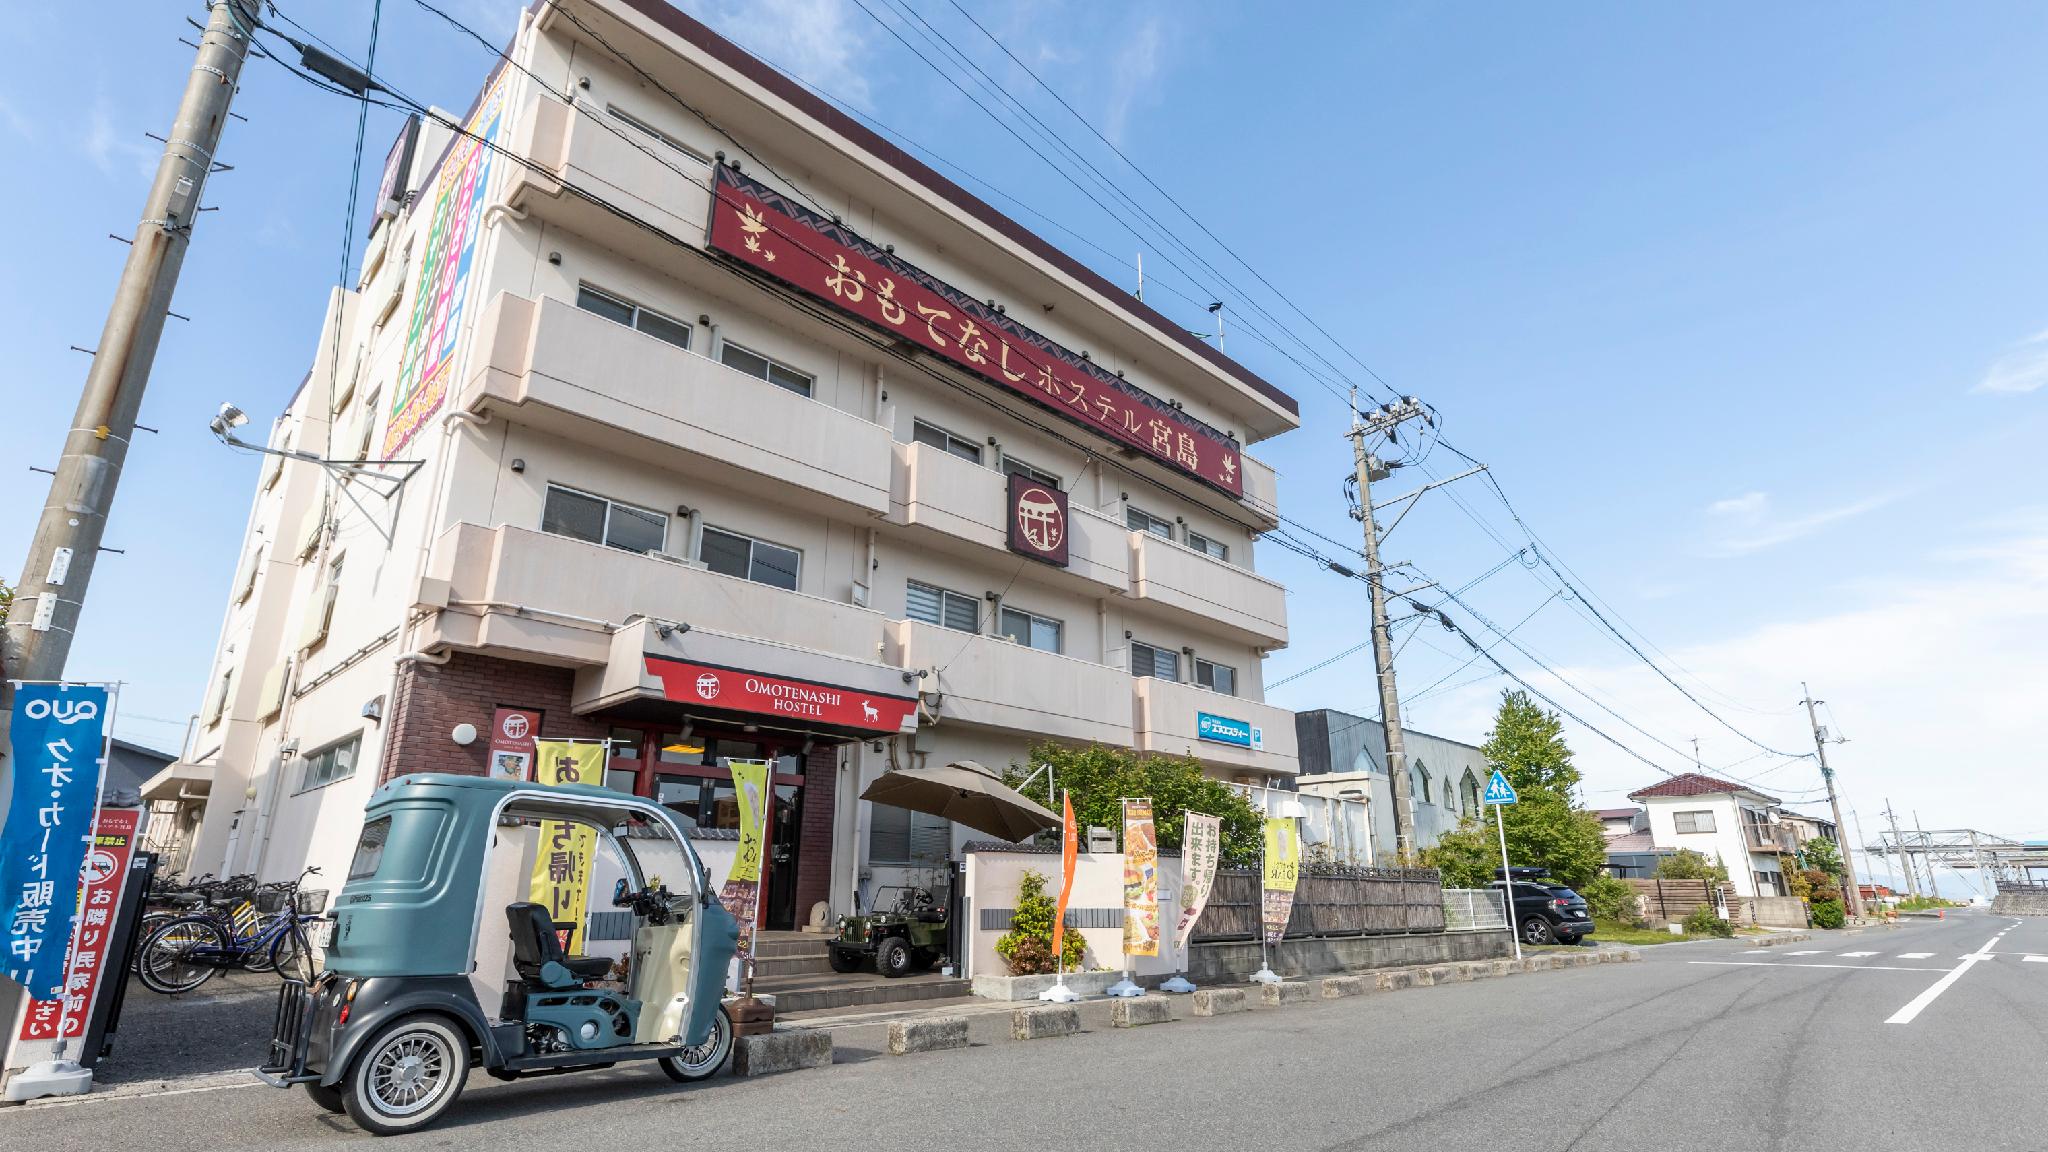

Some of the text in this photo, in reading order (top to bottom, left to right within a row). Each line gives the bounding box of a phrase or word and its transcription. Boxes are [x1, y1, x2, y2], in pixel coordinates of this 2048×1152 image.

[395, 200, 446, 408] キャンプ
[824, 254, 1200, 471] おもてなしホステル宮島
[745, 679, 841, 705] OMOTENASHI
[774, 699, 822, 715] HOSTEL
[93, 836, 125, 846] 車禁止
[1190, 821, 1203, 885] 出来ます。
[1199, 822, 1217, 898] お持ち帰り
[57, 888, 113, 1034] お隣り民家前の
